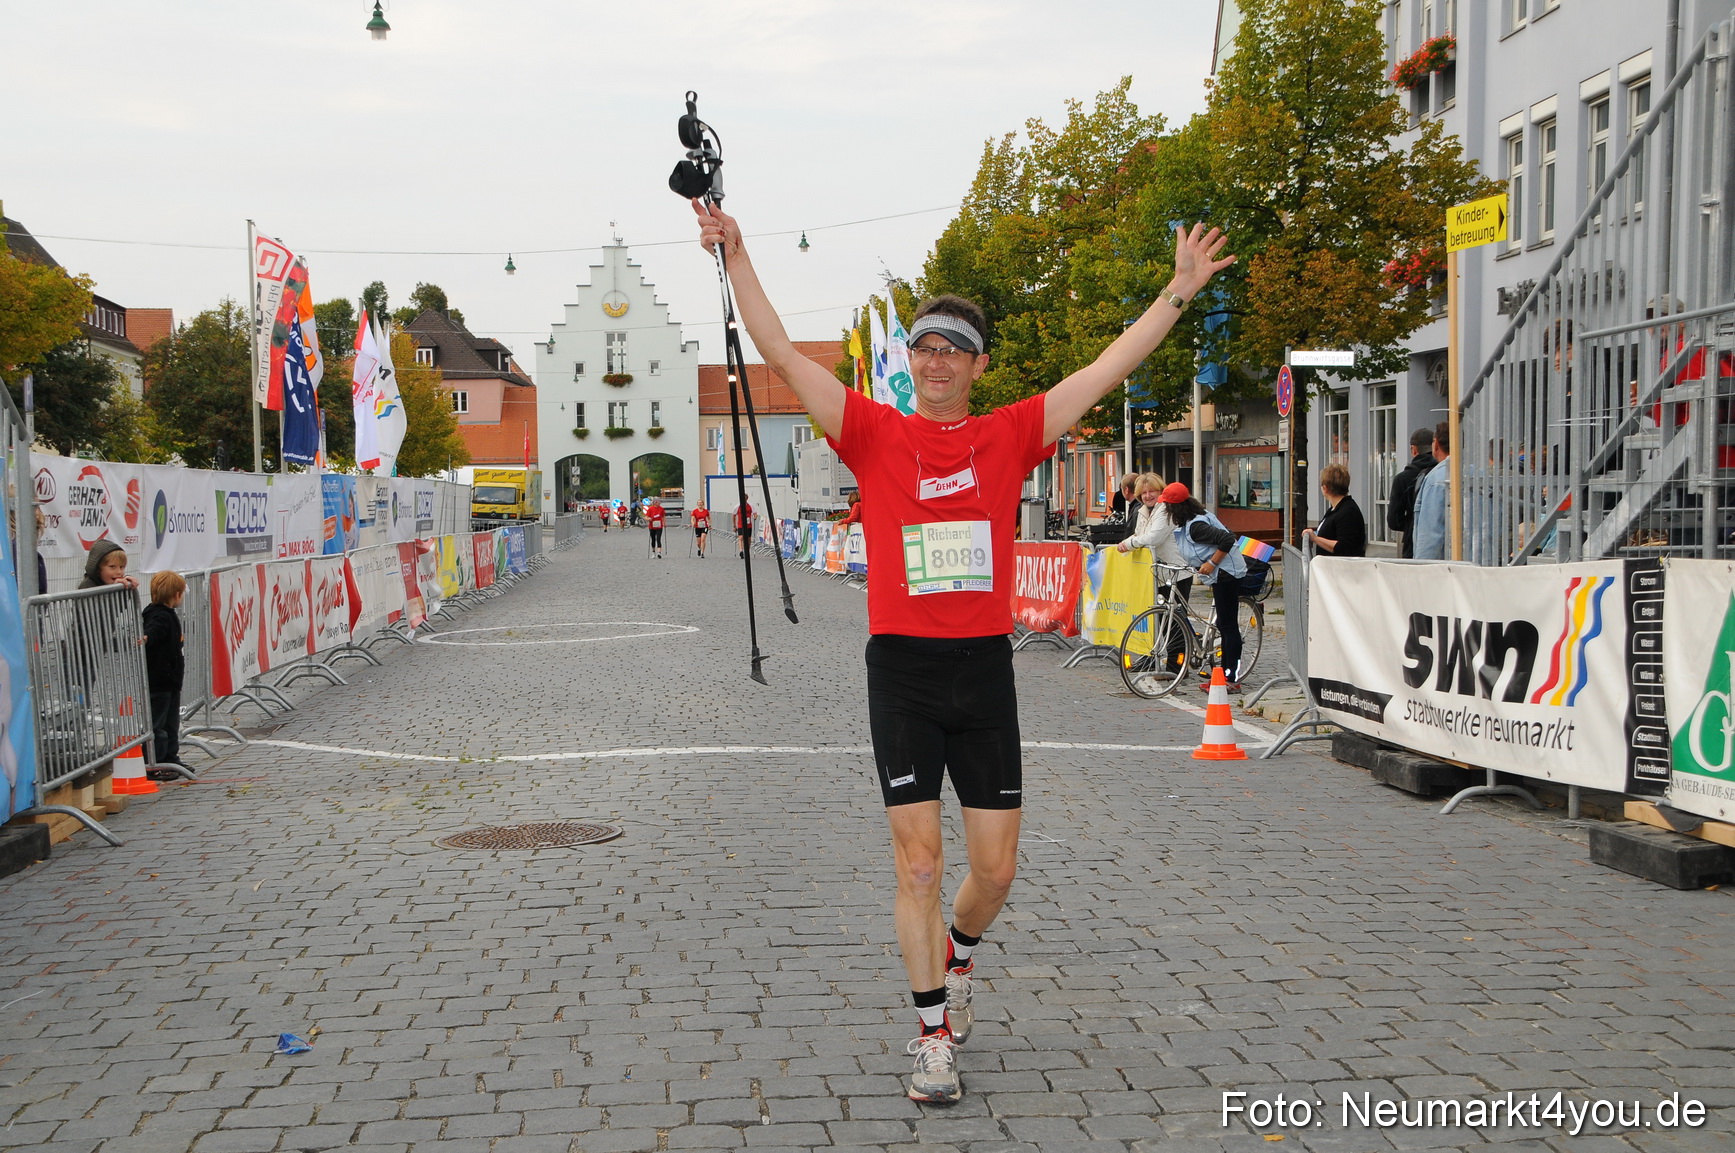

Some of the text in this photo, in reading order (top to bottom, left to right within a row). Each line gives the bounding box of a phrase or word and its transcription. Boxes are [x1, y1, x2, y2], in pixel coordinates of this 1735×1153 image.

[1456, 207, 1489, 226] Kinder-
[1450, 226, 1495, 247] betreuung
[935, 478, 958, 492] DEHN
[168, 506, 206, 534] Bionorica
[225, 491, 268, 534] BOCK
[927, 526, 972, 542] Richard
[288, 541, 301, 557] MAX
[301, 536, 315, 555] BÖGL
[931, 547, 986, 569] 8089
[962, 579, 992, 587] PFLEIDERER
[1640, 577, 1656, 586] Strom
[1402, 612, 1539, 704] swn
[1320, 687, 1381, 714] Leistungen, die verbinden
[1403, 697, 1575, 752] stadtwerke neumarkt
[1637, 763, 1667, 775] Parkhäuser
